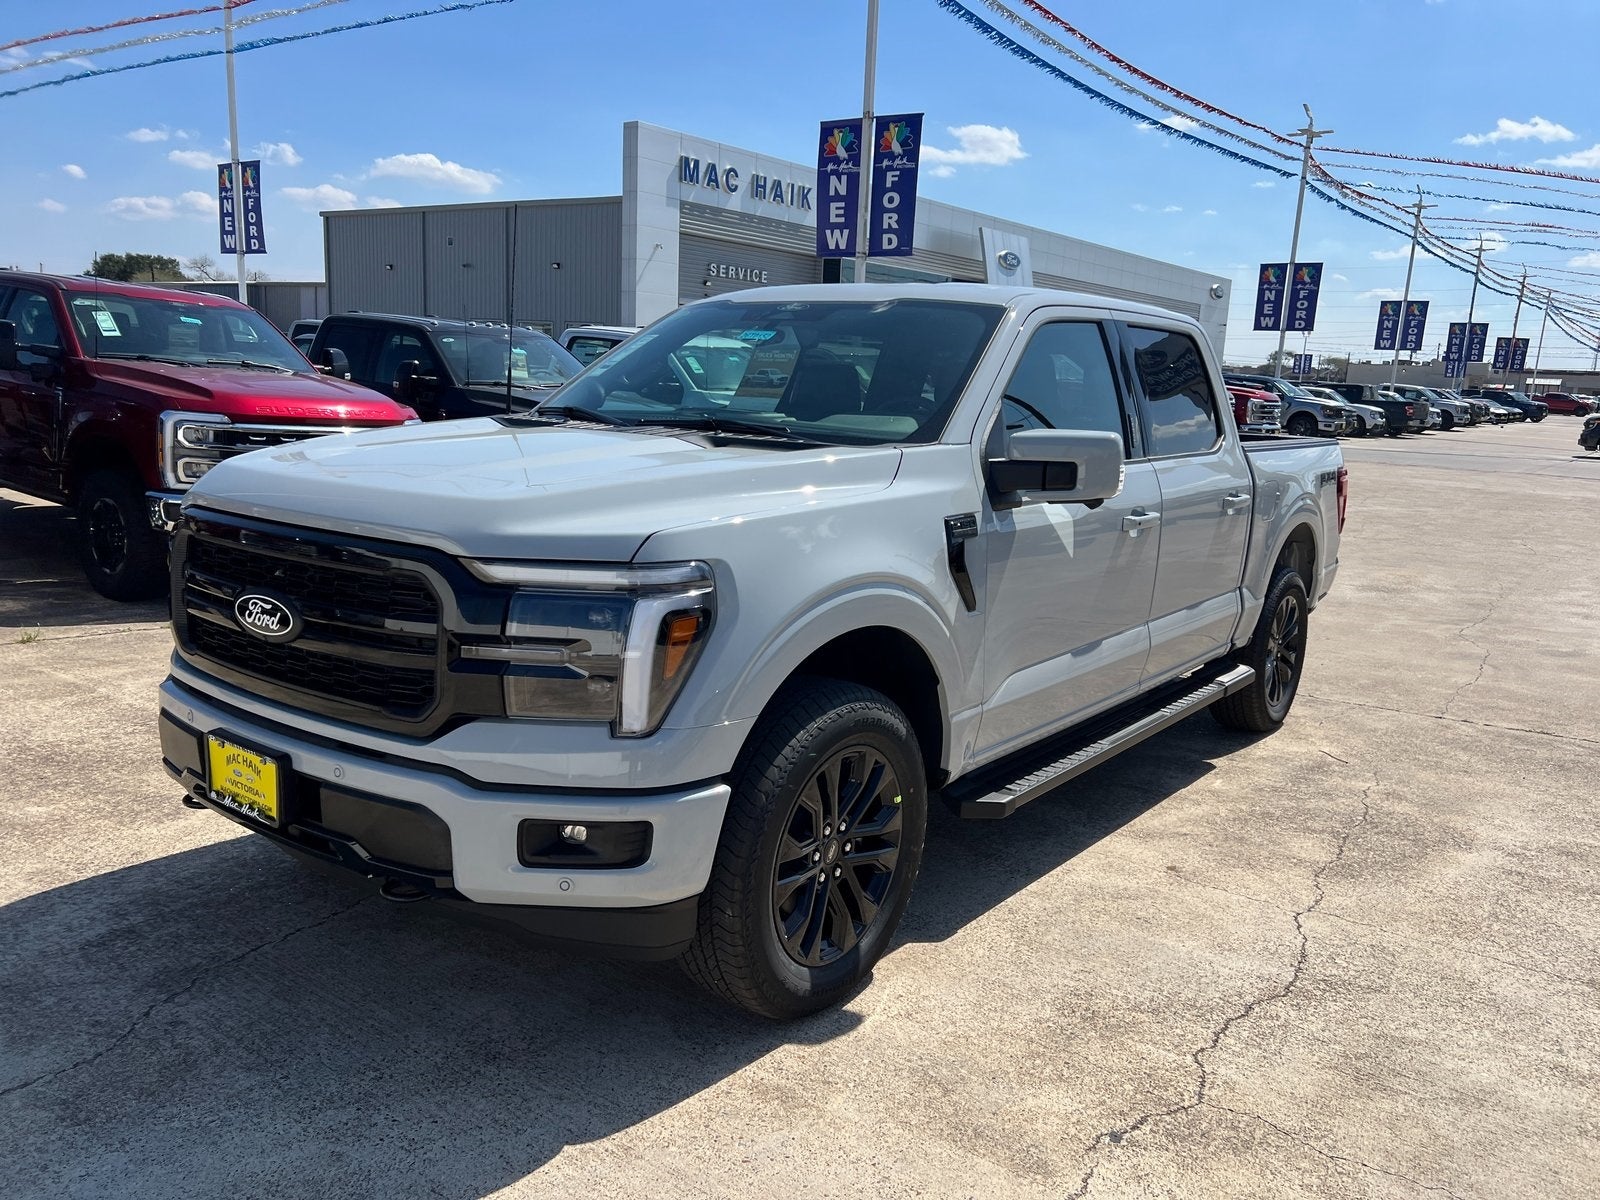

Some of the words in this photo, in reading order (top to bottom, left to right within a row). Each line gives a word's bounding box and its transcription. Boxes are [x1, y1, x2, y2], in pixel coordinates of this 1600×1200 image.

[680, 154, 740, 194] MAC
[752, 173, 813, 210] HAIK
[223, 199, 235, 249] NEW
[247, 199, 259, 250] FORD
[825, 174, 849, 250] NEW
[882, 171, 900, 250] FORD
[710, 263, 768, 283] SERVICE
[1260, 290, 1275, 328] NEW
[1294, 290, 1309, 329] FORD
[1380, 320, 1393, 348] NEW
[1406, 320, 1418, 349] FORD
[1449, 338, 1460, 360] NEW
[1471, 338, 1480, 360] FORD
[1496, 350, 1505, 368] NEW
[1513, 350, 1521, 369] FORD
[256, 406, 334, 417] SUPER
[245, 599, 281, 630] Ford
[226, 753, 241, 767] MAC
[242, 755, 262, 780] HAIK
[230, 777, 260, 797] VICTORIA
[223, 795, 239, 808] Mac
